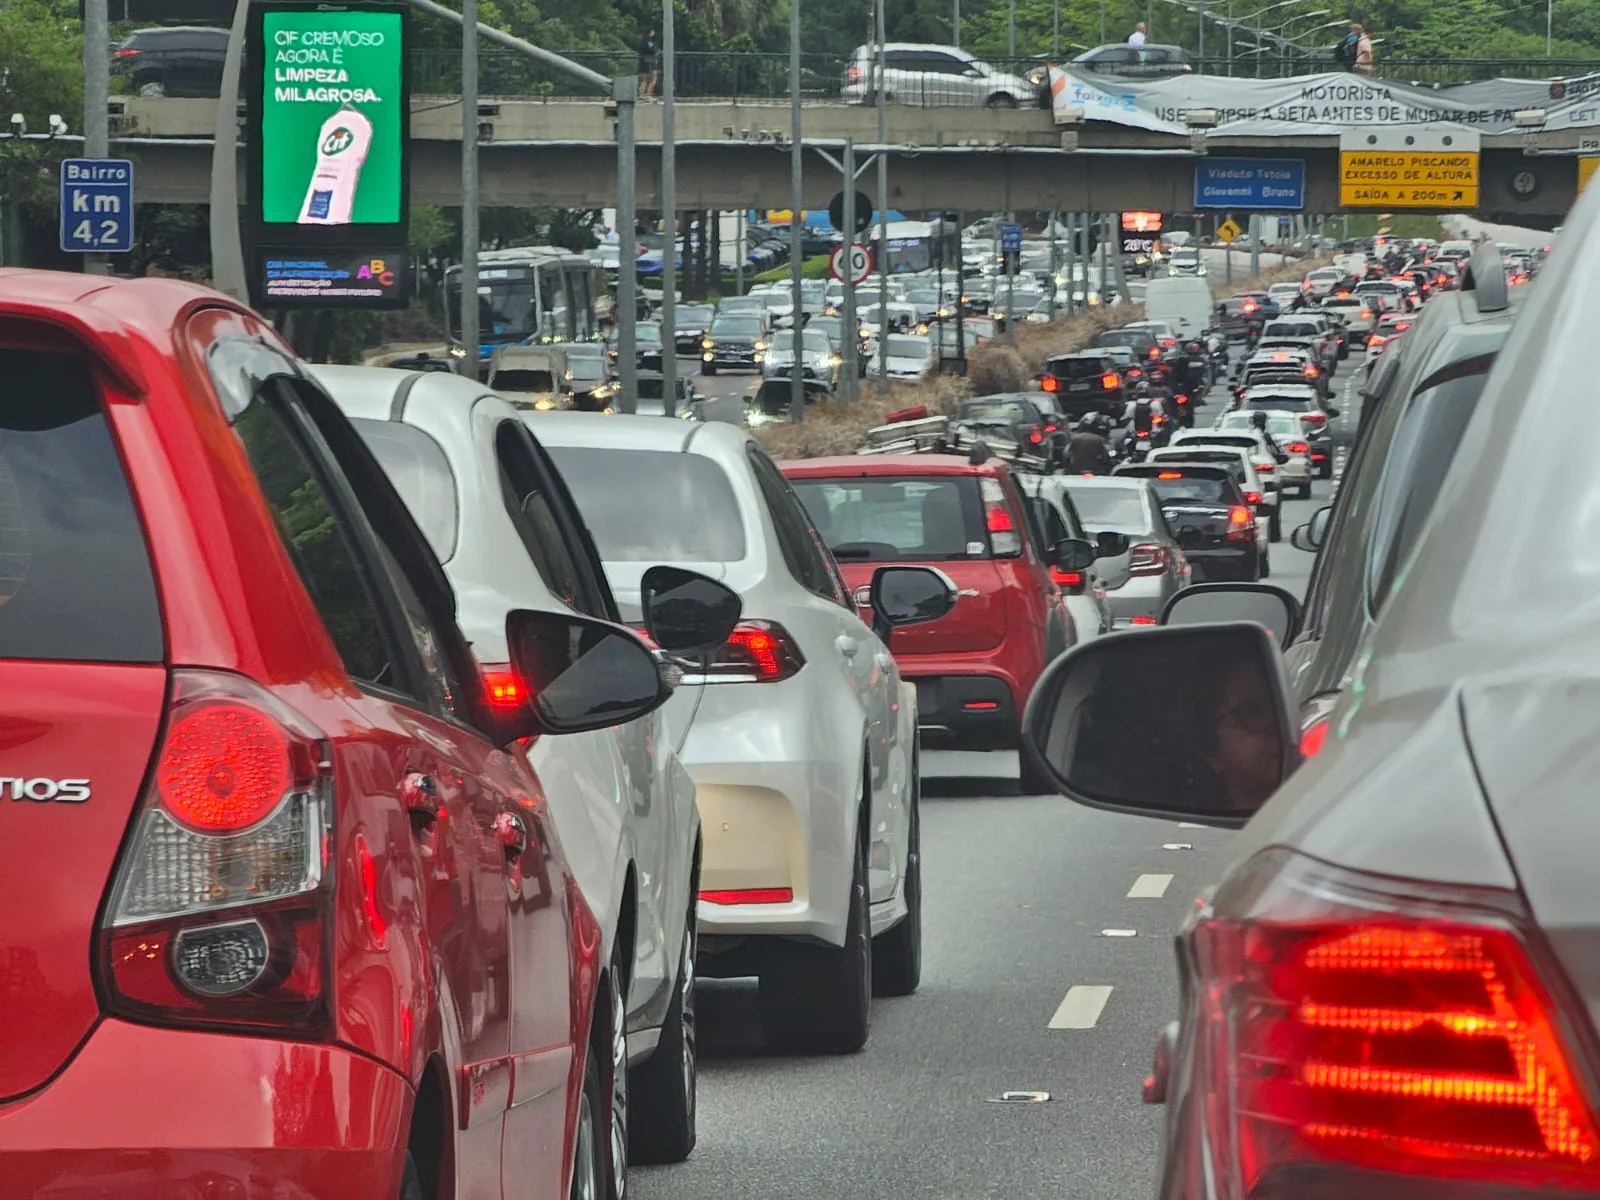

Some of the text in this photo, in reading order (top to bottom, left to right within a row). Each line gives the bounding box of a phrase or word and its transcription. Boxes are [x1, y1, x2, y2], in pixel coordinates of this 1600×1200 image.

[274, 30, 385, 47] CIF CREMOSO
[275, 46, 344, 65] AGORA É
[275, 67, 349, 83] LIMPEZA
[275, 87, 383, 103] MILAGROSA.
[1301, 86, 1393, 101] MOTORISTA
[1155, 107, 1186, 123] USE
[1278, 106, 1319, 121] SETA
[1320, 106, 1378, 121] ANTES
[1378, 106, 1401, 121] DE
[1405, 108, 1465, 123] MUDAR
[1467, 110, 1490, 123] DE
[1569, 108, 1598, 122] CET
[1350, 157, 1470, 167] AMARELO PISCANDO
[67, 165, 127, 180] Bairro
[1345, 170, 1472, 181] EXCESSO DE ALTURA
[1203, 186, 1296, 198] Giovanni Bruno
[1354, 189, 1448, 200] SAÍDA A 200m
[73, 189, 120, 213] km
[72, 220, 120, 247] 4,2
